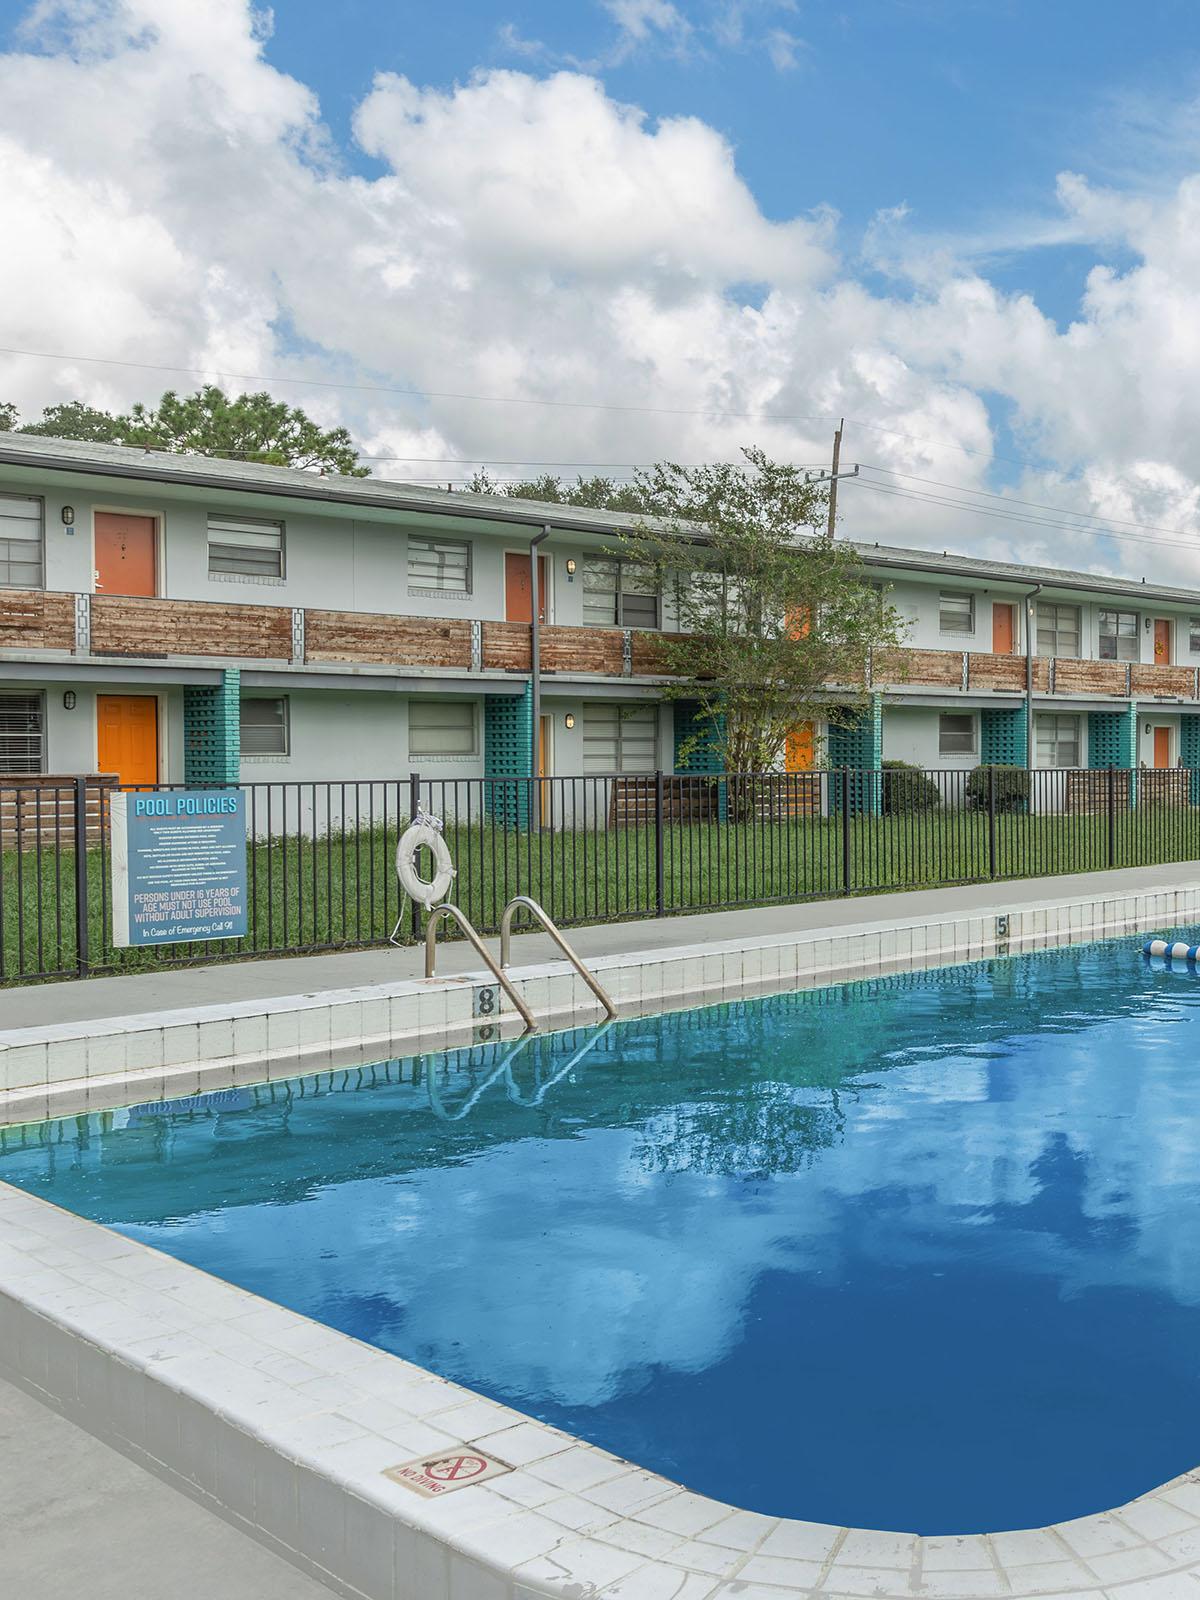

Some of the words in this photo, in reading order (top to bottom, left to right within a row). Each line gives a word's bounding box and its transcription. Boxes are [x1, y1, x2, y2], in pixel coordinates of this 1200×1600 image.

[136, 799, 173, 816] POOL
[177, 797, 237, 815] POLICIES
[134, 892, 169, 904] PERSONS
[171, 890, 195, 901] UNDER
[197, 889, 204, 899] 16
[206, 888, 229, 898] YEARS
[230, 887, 240, 896] OF
[143, 903, 157, 912] AGE
[159, 901, 180, 911] MUST
[182, 899, 196, 909] NOT
[198, 898, 212, 908] USE
[214, 897, 232, 907] POOL
[134, 911, 169, 923] WITHOUT
[170, 909, 193, 920] ADULT
[195, 906, 241, 918] SUPERVISION
[142, 929, 150, 938] In
[150, 927, 167, 937] Case
[168, 926, 177, 936] of
[176, 925, 211, 936] Emergency
[211, 922, 224, 931] Call
[998, 917, 1007, 935] 5
[479, 988, 494, 1014] 8
[398, 1467, 416, 1478] NO
[411, 1473, 446, 1493] DIVING
